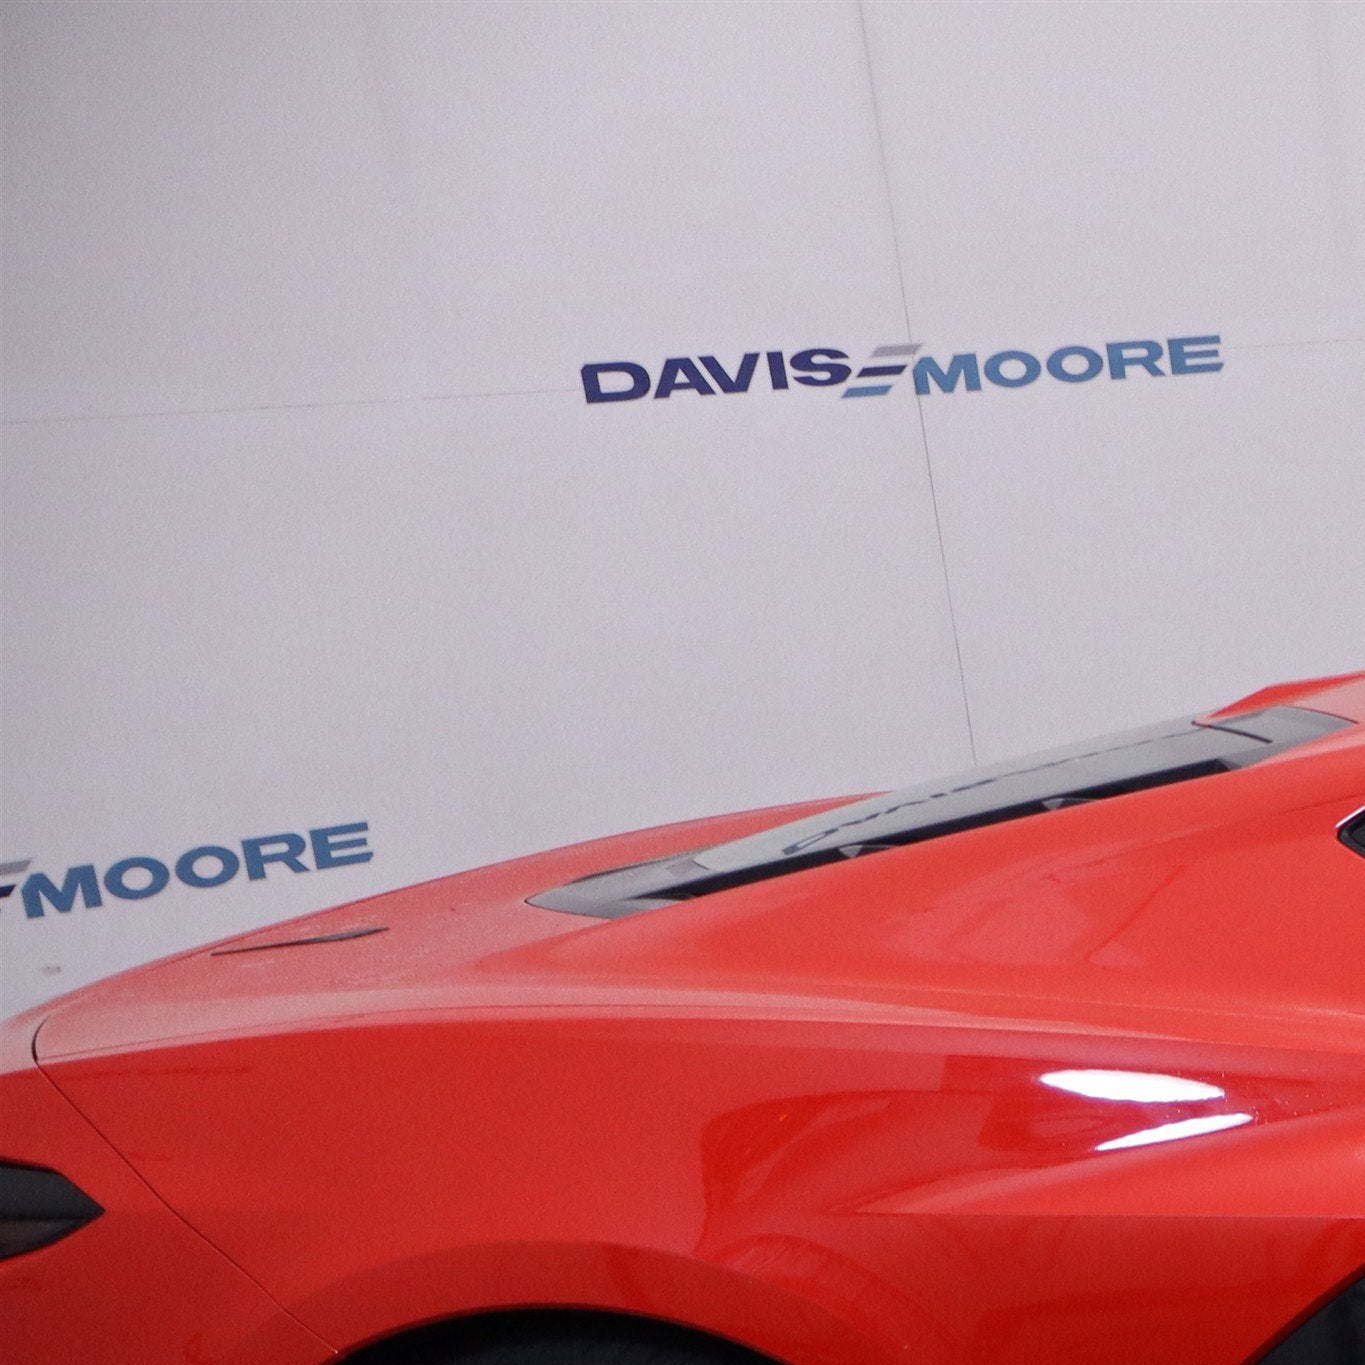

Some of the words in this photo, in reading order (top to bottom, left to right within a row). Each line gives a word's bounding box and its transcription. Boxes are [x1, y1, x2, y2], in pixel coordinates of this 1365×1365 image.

[581, 347, 851, 402] DAVIS
[912, 334, 1224, 395] MOORE
[20, 820, 374, 919] MOORE
